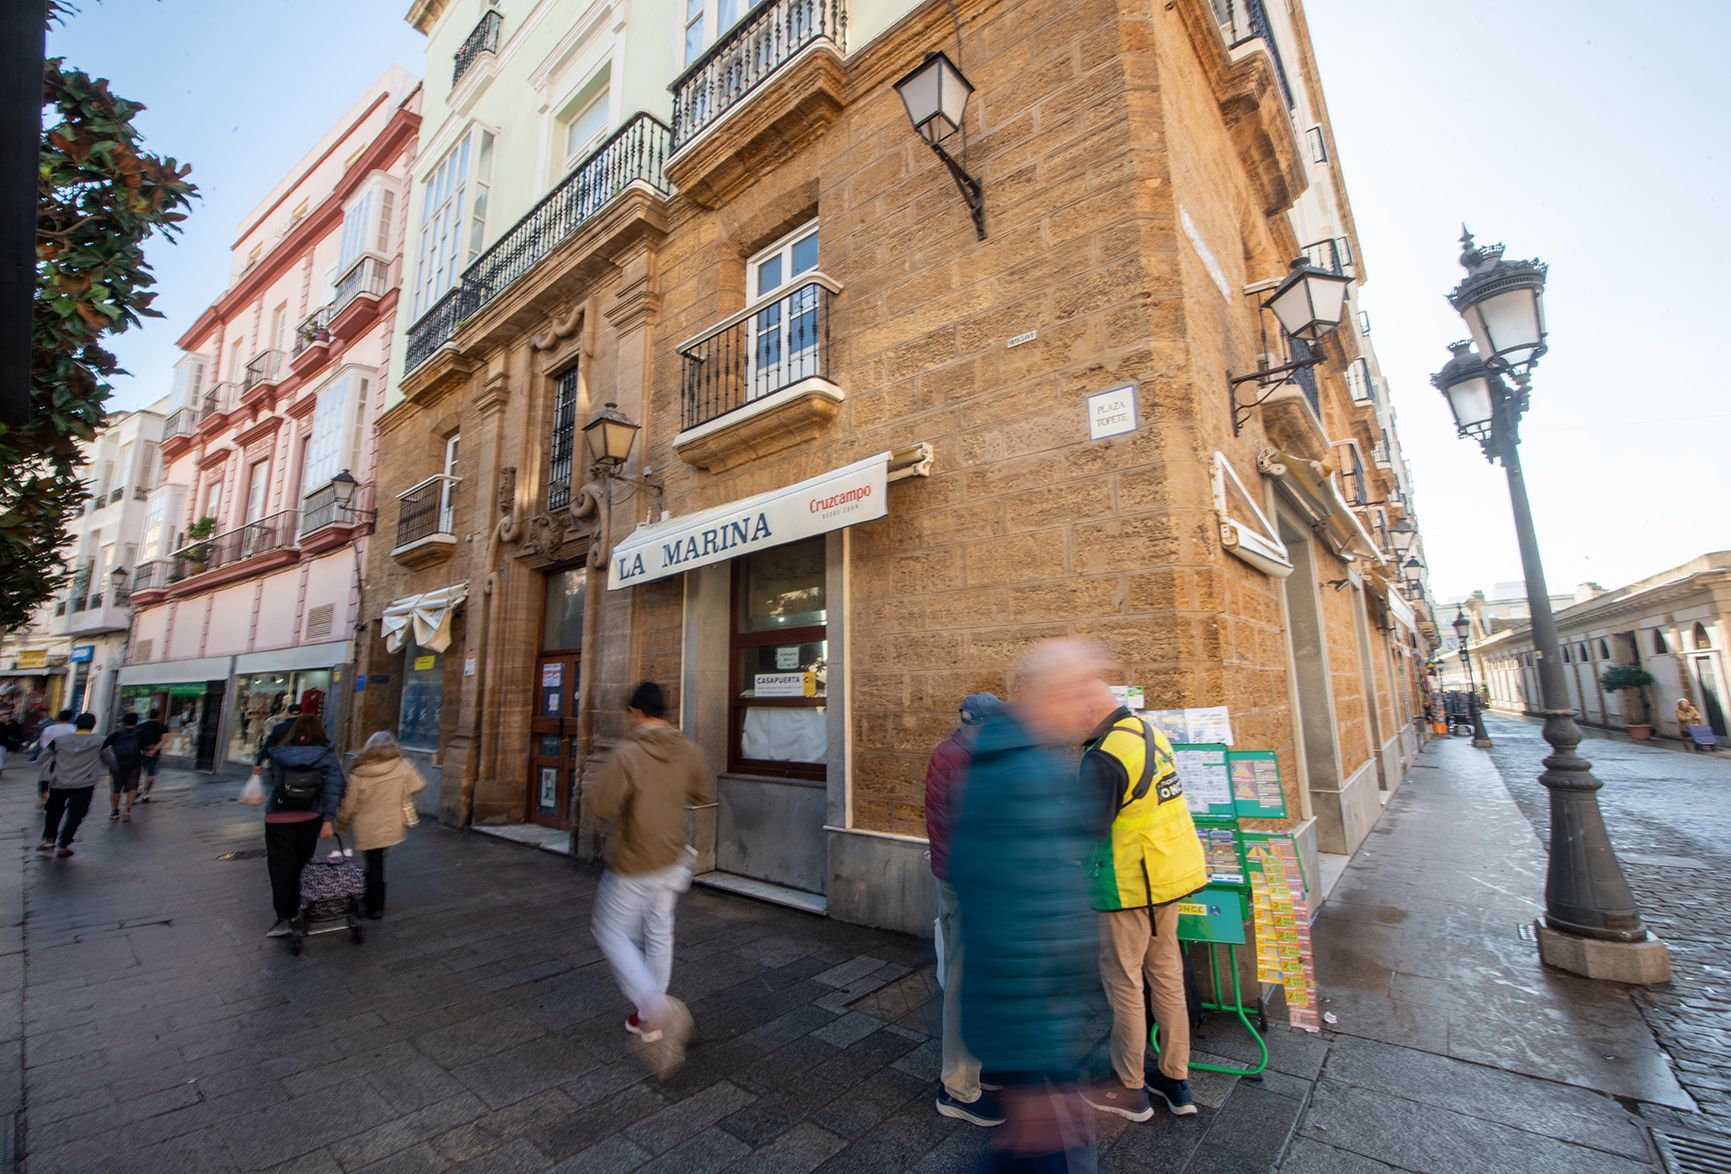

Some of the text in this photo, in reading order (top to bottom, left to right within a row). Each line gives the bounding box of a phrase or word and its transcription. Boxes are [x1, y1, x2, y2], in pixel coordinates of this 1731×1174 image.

[1097, 401, 1125, 414] PLAZA
[1096, 413, 1128, 427] TOPETE
[809, 485, 871, 513] Cruzcampo
[619, 512, 772, 581] LA MARINA
[757, 676, 800, 684] CASAPUERTA
